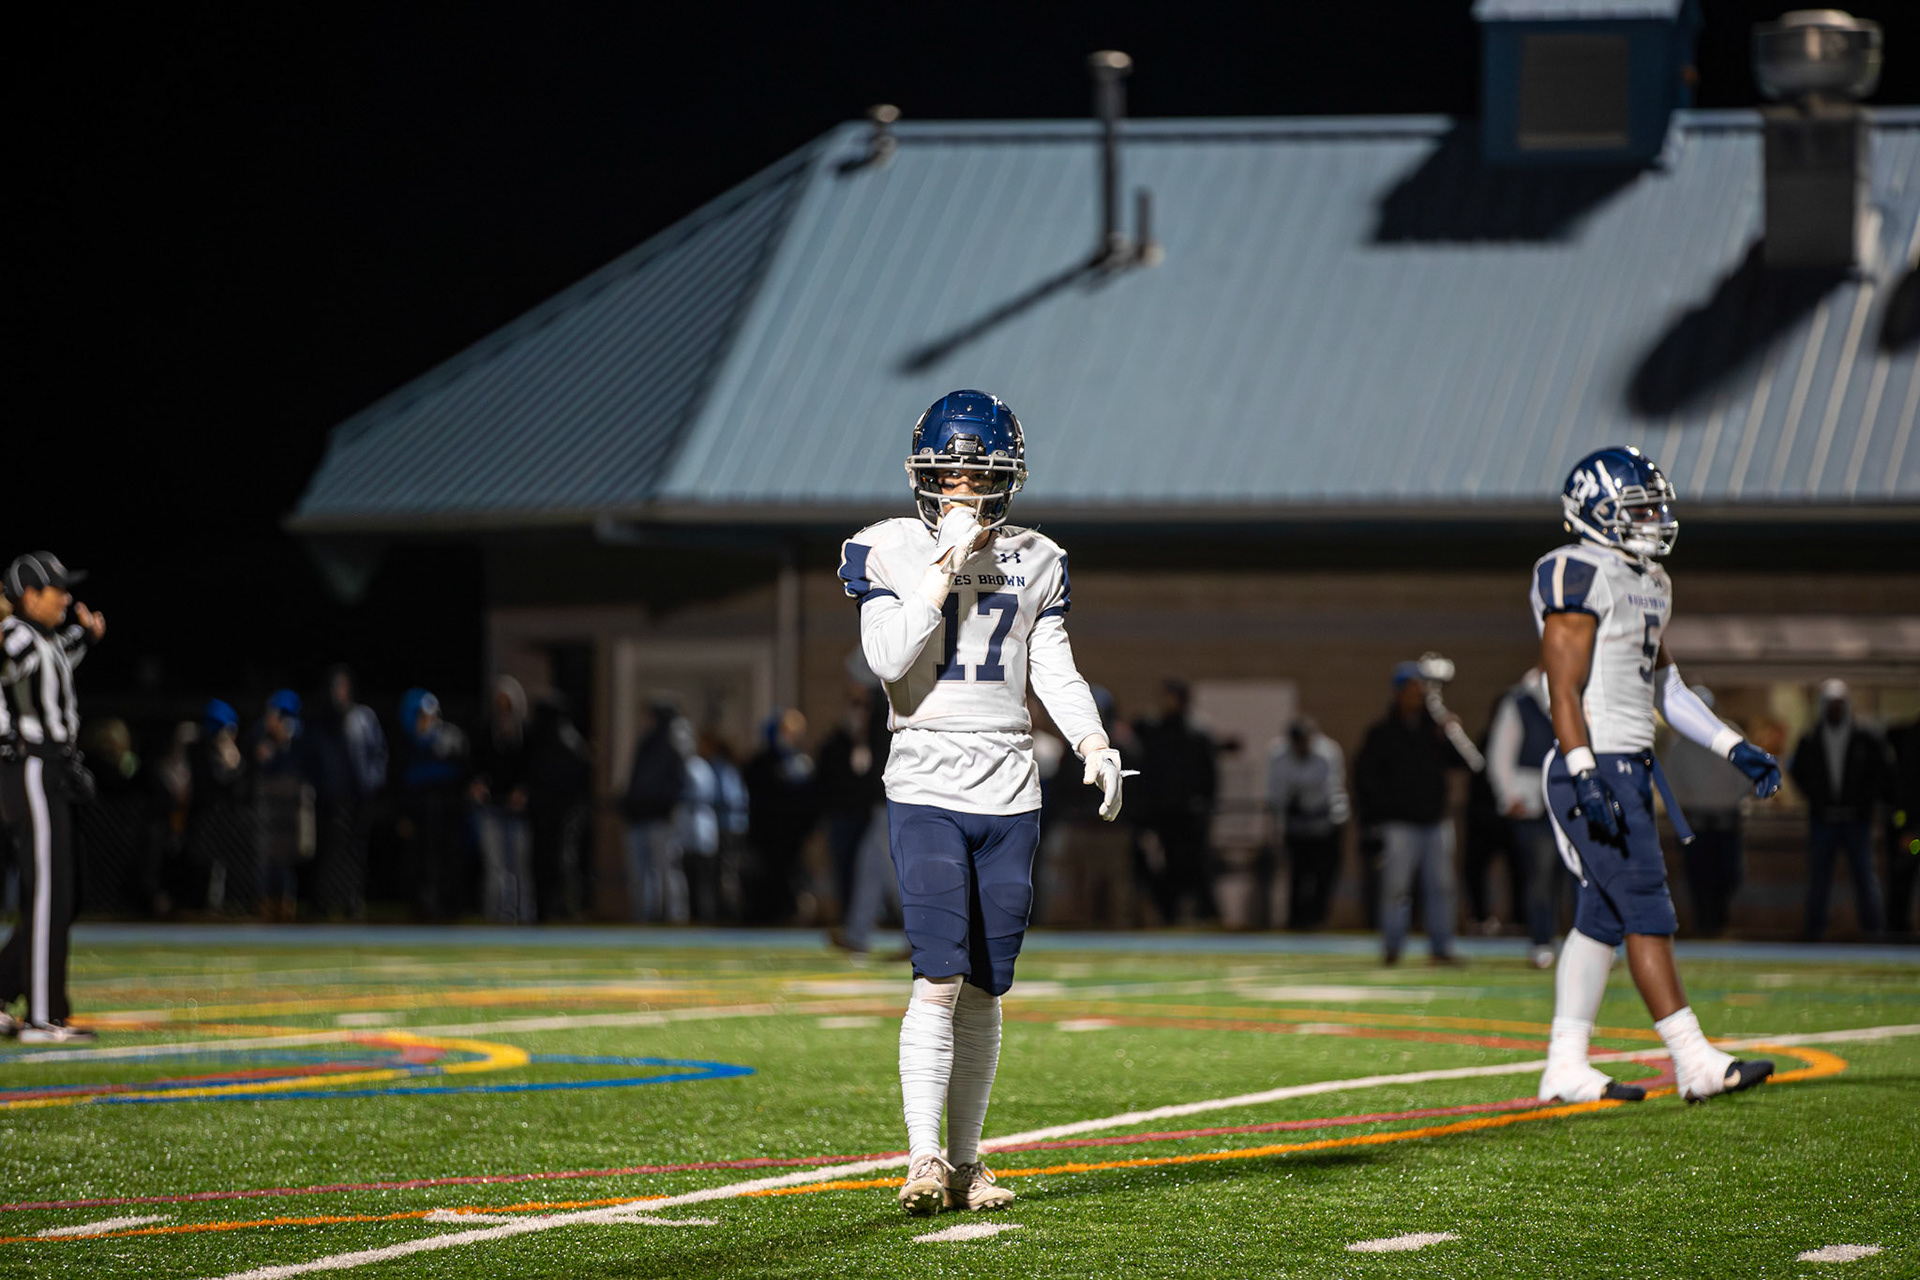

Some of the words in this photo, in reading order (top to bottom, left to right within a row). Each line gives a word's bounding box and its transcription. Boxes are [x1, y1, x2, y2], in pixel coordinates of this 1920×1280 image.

[954, 574, 972, 586] ES
[978, 574, 1026, 587] BROWN
[935, 591, 1020, 682] 17
[1639, 613, 1660, 684] 5
